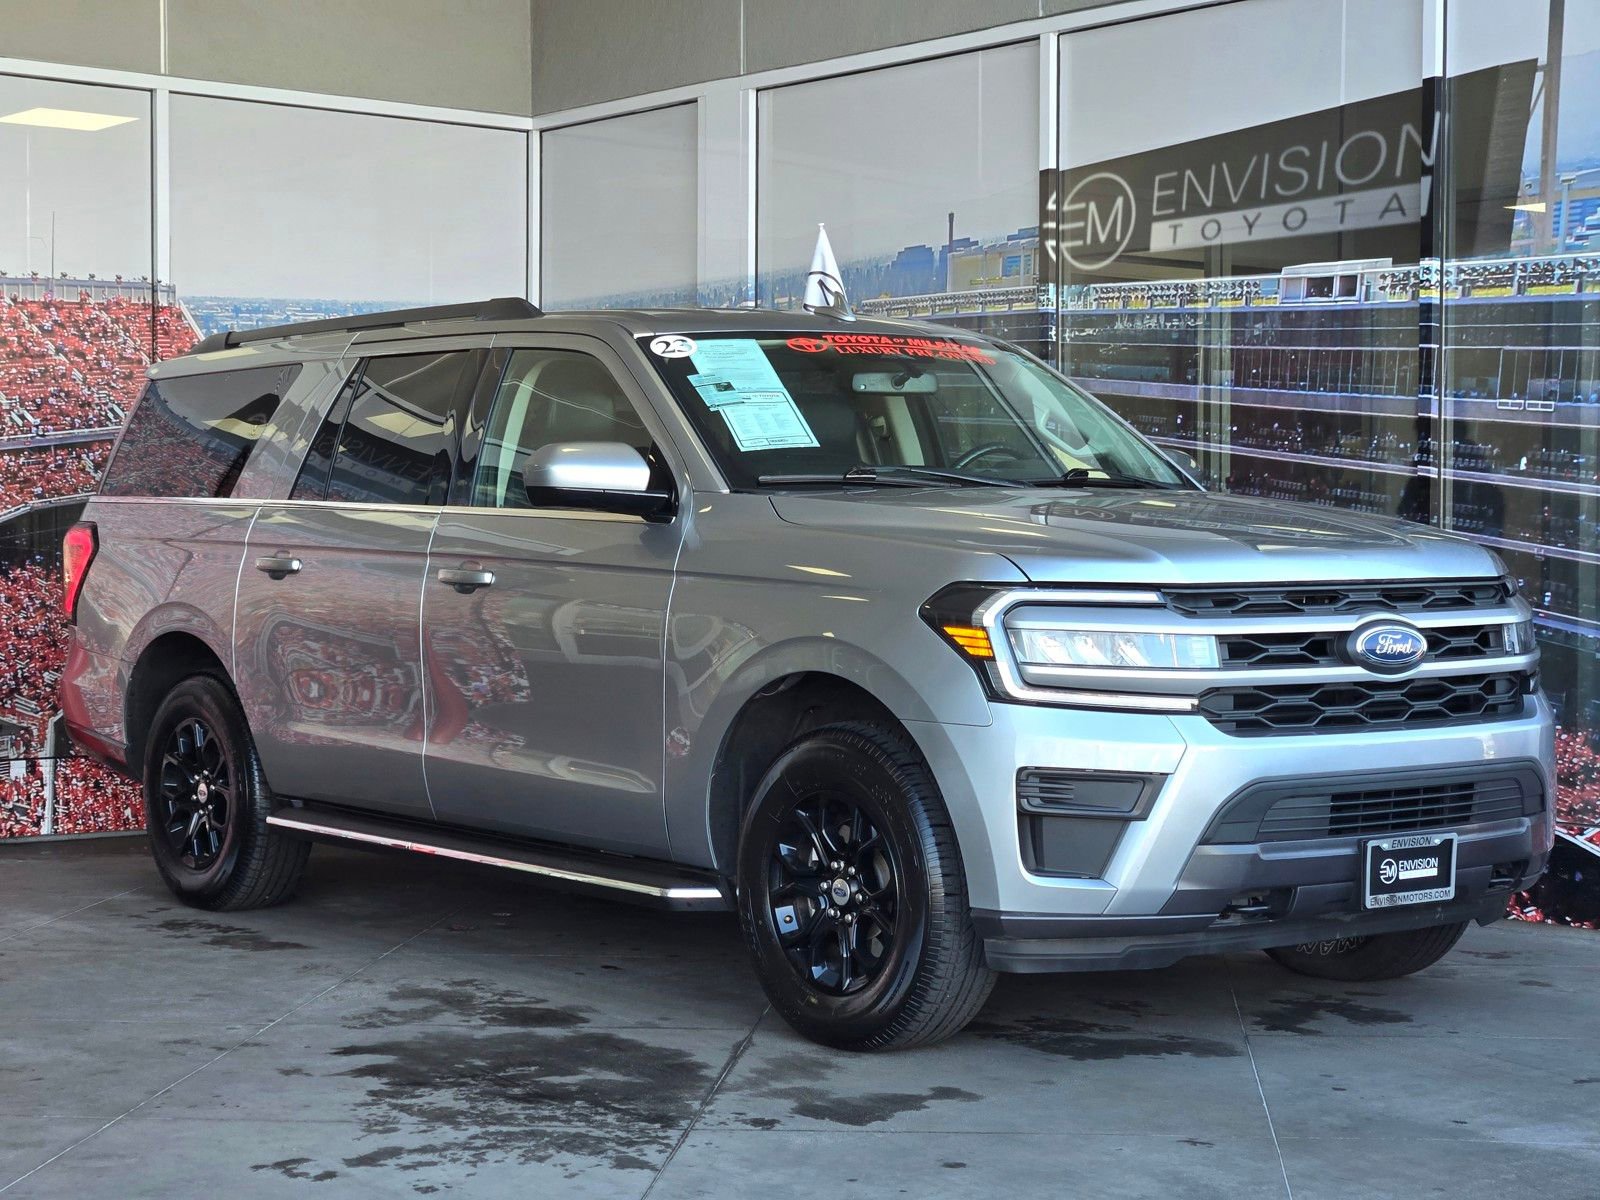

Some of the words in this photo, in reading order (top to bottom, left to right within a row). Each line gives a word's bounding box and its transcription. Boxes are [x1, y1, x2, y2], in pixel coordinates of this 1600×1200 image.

[1153, 111, 1440, 216] ENVISION
[1168, 192, 1407, 245] TOYOTA
[656, 338, 692, 354] 23
[822, 335, 893, 344] TOYOTA
[834, 345, 904, 355] LUXURY
[1376, 633, 1412, 655] Ford
[1391, 836, 1432, 849] ENVISION
[1399, 857, 1439, 871] ENVISION
